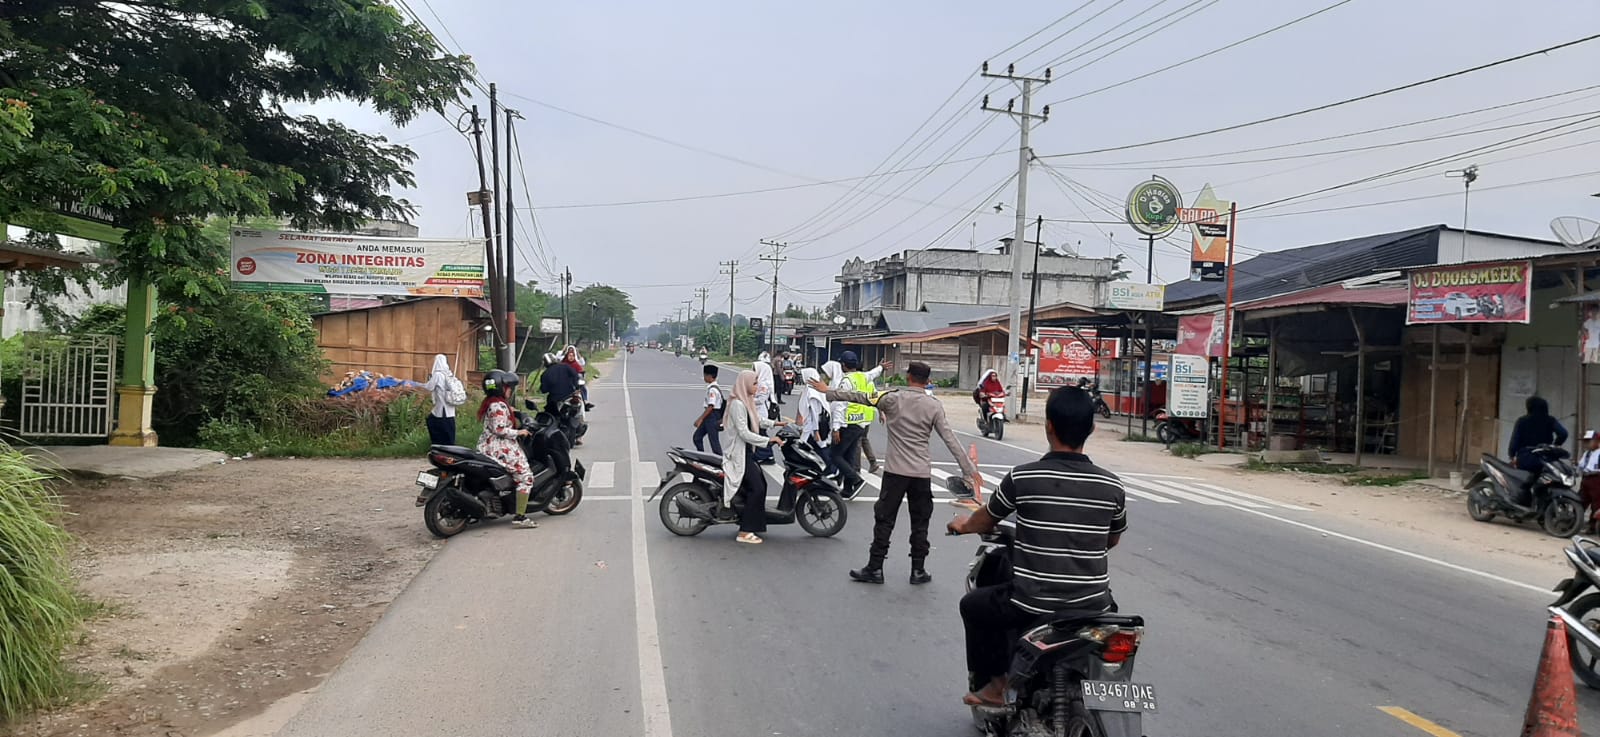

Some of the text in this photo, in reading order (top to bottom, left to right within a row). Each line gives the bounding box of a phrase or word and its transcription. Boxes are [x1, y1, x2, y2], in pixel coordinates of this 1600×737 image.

[278, 233, 318, 241] SELAMAT
[356, 244, 425, 254] ANDA MEMASUKI
[296, 253, 425, 268] ZONA INTEGRITAS
[1431, 265, 1522, 287] DOORSMEER
[1112, 287, 1130, 297] BSI
[1175, 364, 1192, 374] BSI
[1131, 684, 1154, 700] DAE
